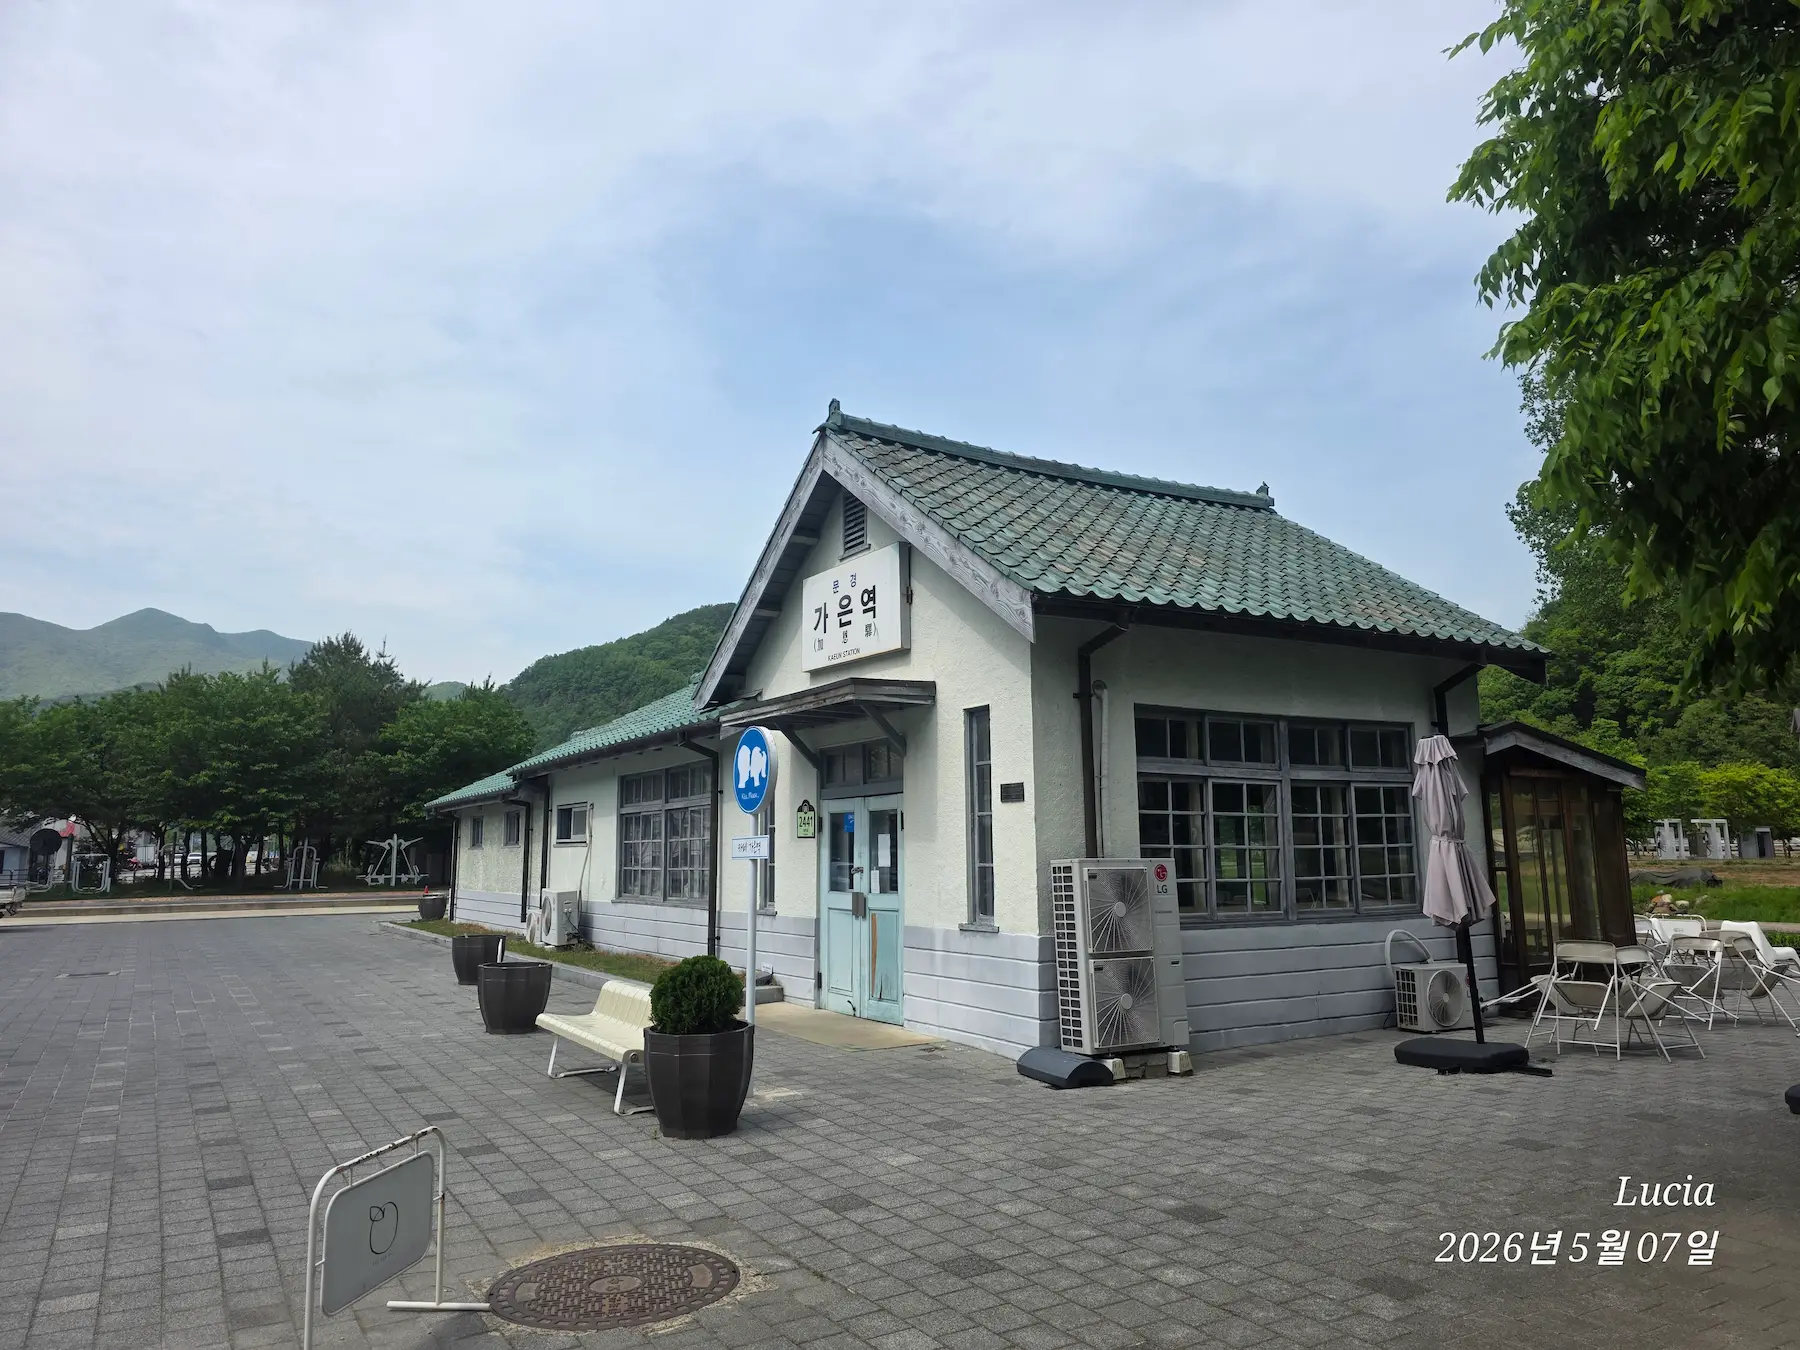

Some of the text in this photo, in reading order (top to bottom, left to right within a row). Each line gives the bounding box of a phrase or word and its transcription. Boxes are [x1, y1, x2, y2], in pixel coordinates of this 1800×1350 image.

[832, 573, 857, 594] 문경
[813, 584, 876, 634] 가은역
[828, 647, 860, 662] KAEUN STATION
[799, 816, 813, 827] 2441
[1156, 884, 1168, 893] LG
